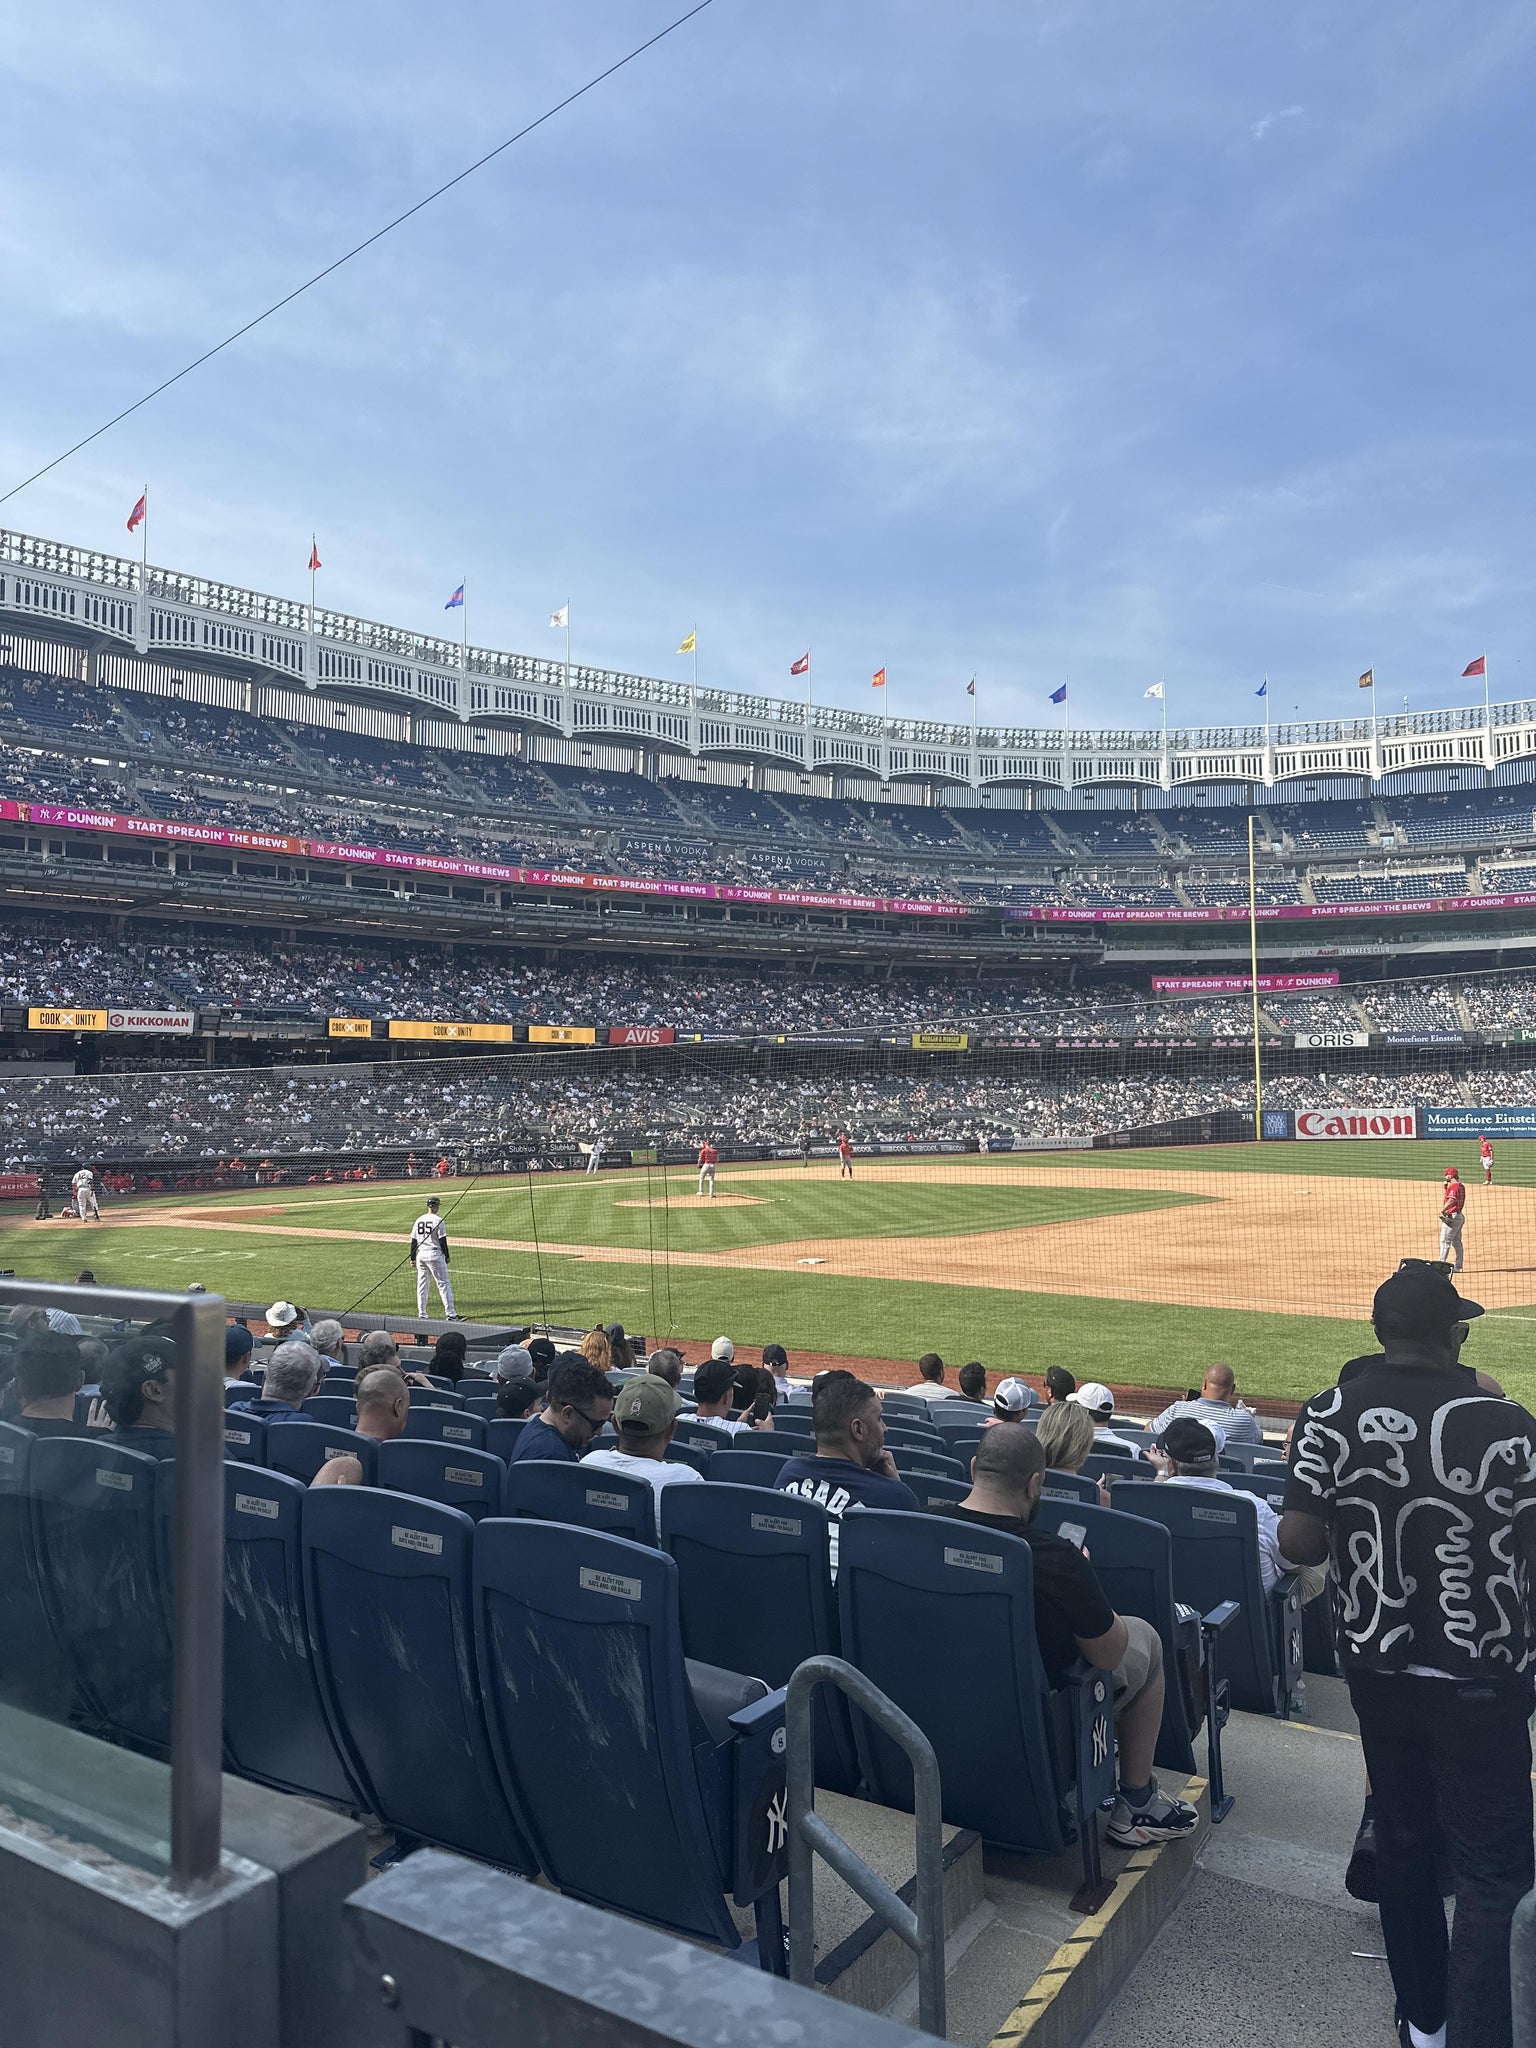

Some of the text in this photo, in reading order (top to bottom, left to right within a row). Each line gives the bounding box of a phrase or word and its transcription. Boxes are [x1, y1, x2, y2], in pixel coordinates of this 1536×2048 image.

[68, 812, 117, 827] DUNKIN'
[128, 821, 163, 833] START
[166, 825, 225, 840] SPREADIN'
[228, 833, 249, 844] THE
[251, 836, 288, 849] BREWS
[627, 841, 709, 856] ASPEN VODKA
[338, 847, 376, 860] DUNKIN'
[385, 854, 414, 865] START
[416, 858, 461, 871] SPREADIN'
[463, 864, 480, 873] THE
[482, 866, 510, 878] BREWS
[794, 858, 825, 868] VODKA
[552, 874, 586, 885] DUNKIN'
[593, 878, 618, 887] START
[620, 880, 661, 890] SPREADIN'
[663, 884, 679, 892] THE
[680, 885, 706, 895] BREWS
[743, 890, 772, 899] DUNKIN'
[778, 893, 800, 902] START
[801, 895, 838, 904] SPREADIN'
[853, 899, 876, 908] BREWS
[1471, 898, 1505, 907] DUNKIN'
[907, 903, 932, 912] DUNKIN'
[937, 906, 958, 914] START
[1338, 905, 1382, 913] SPREADIN'
[1402, 902, 1431, 911] BREWS
[1102, 911, 1124, 919] START
[1126, 911, 1165, 919] SPREADIN'
[1341, 947, 1371, 955] YANKEES
[1156, 981, 1180, 989] START
[1182, 980, 1224, 988] SPREADIN'
[1296, 977, 1334, 986] DUNKIN'
[40, 1013, 97, 1026] COOK UNITY
[127, 1016, 189, 1027] KIKKOMAN
[331, 1023, 368, 1032] COOK UNITY
[433, 1026, 473, 1037] COOK UNITY
[625, 1030, 660, 1043] AVIS
[1309, 1034, 1354, 1047] ORIS
[1387, 1034, 1462, 1043] Montefiore Einstein
[1428, 1113, 1492, 1124] Montefiore
[1297, 1113, 1413, 1136] Canon
[1268, 1127, 1284, 1135] LIFE
[550, 1143, 576, 1151] StubHub
[418, 1221, 433, 1235] 85
